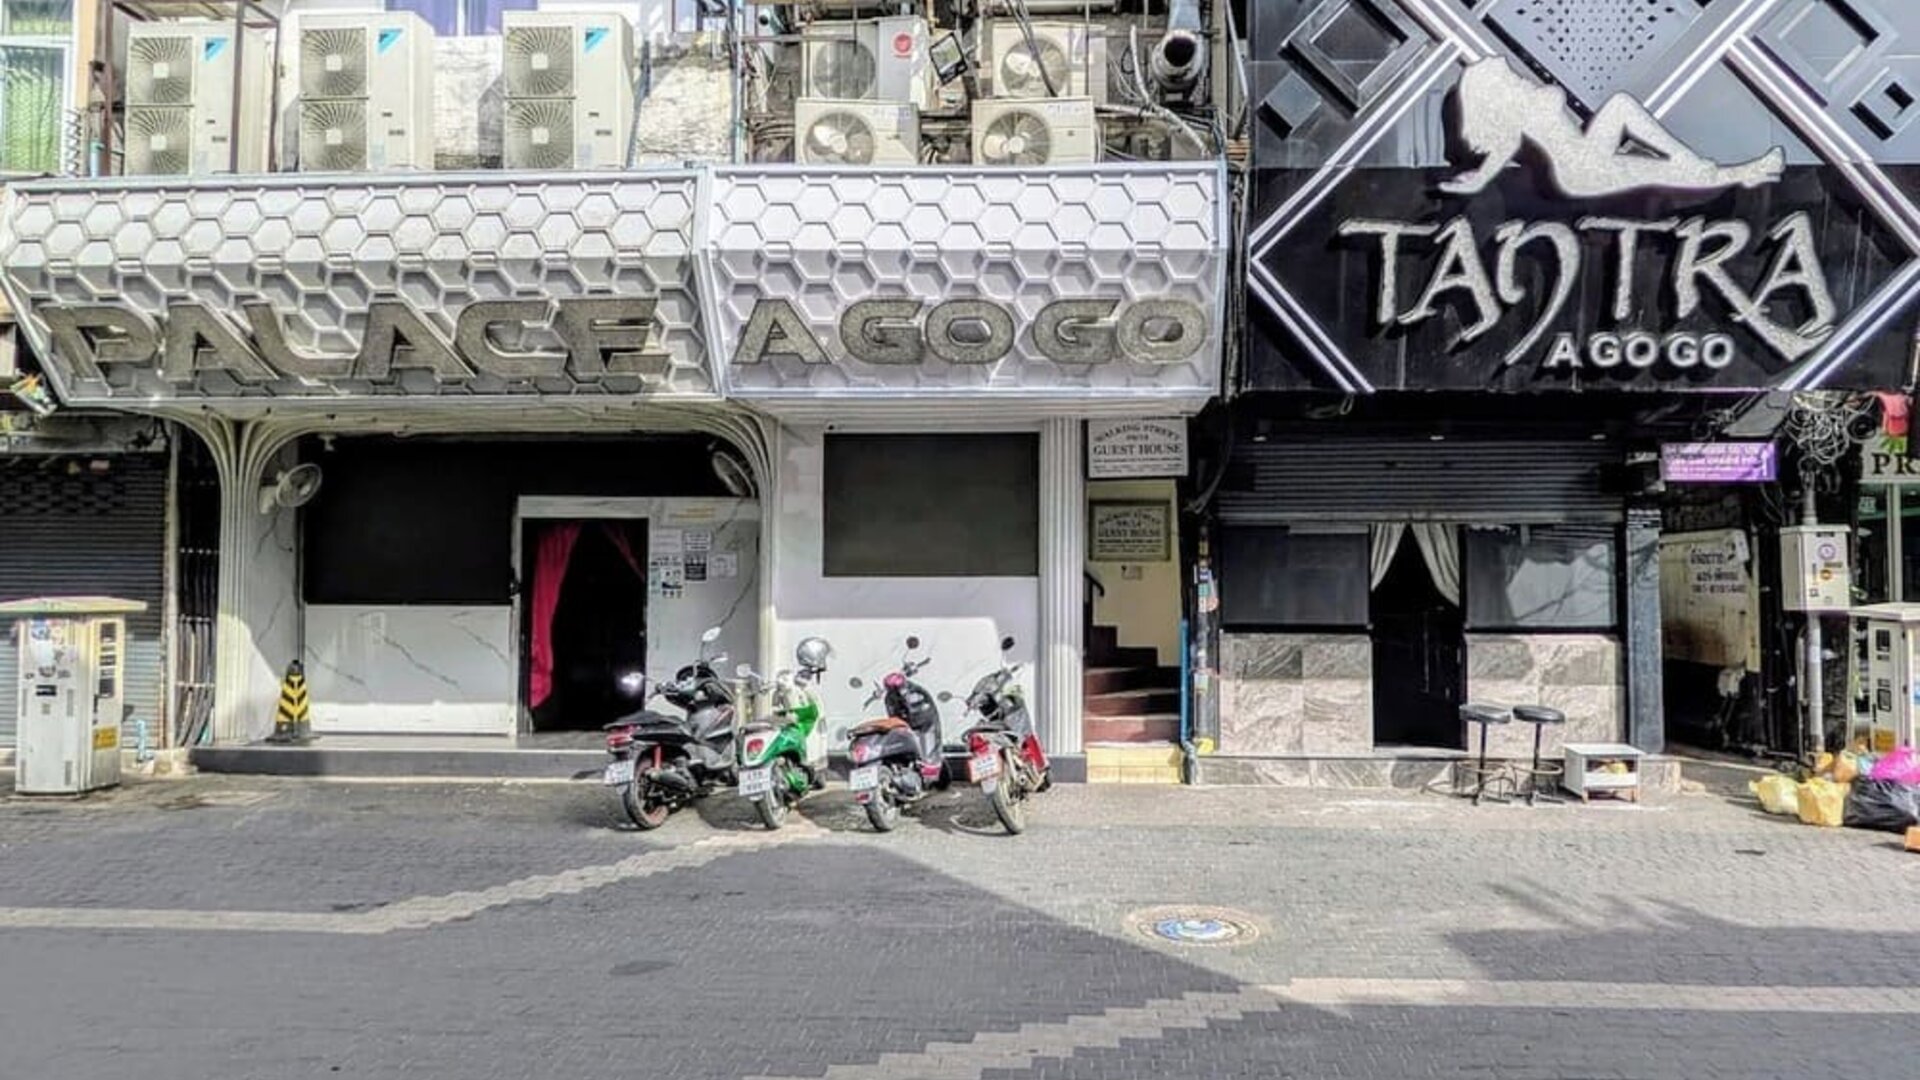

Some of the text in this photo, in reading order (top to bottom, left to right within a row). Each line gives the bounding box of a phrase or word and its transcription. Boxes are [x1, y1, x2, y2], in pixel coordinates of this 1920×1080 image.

[1338, 211, 1837, 365] TANTRA
[34, 298, 670, 386] PALACE
[1093, 443, 1183, 456] GUEST HOUSE
